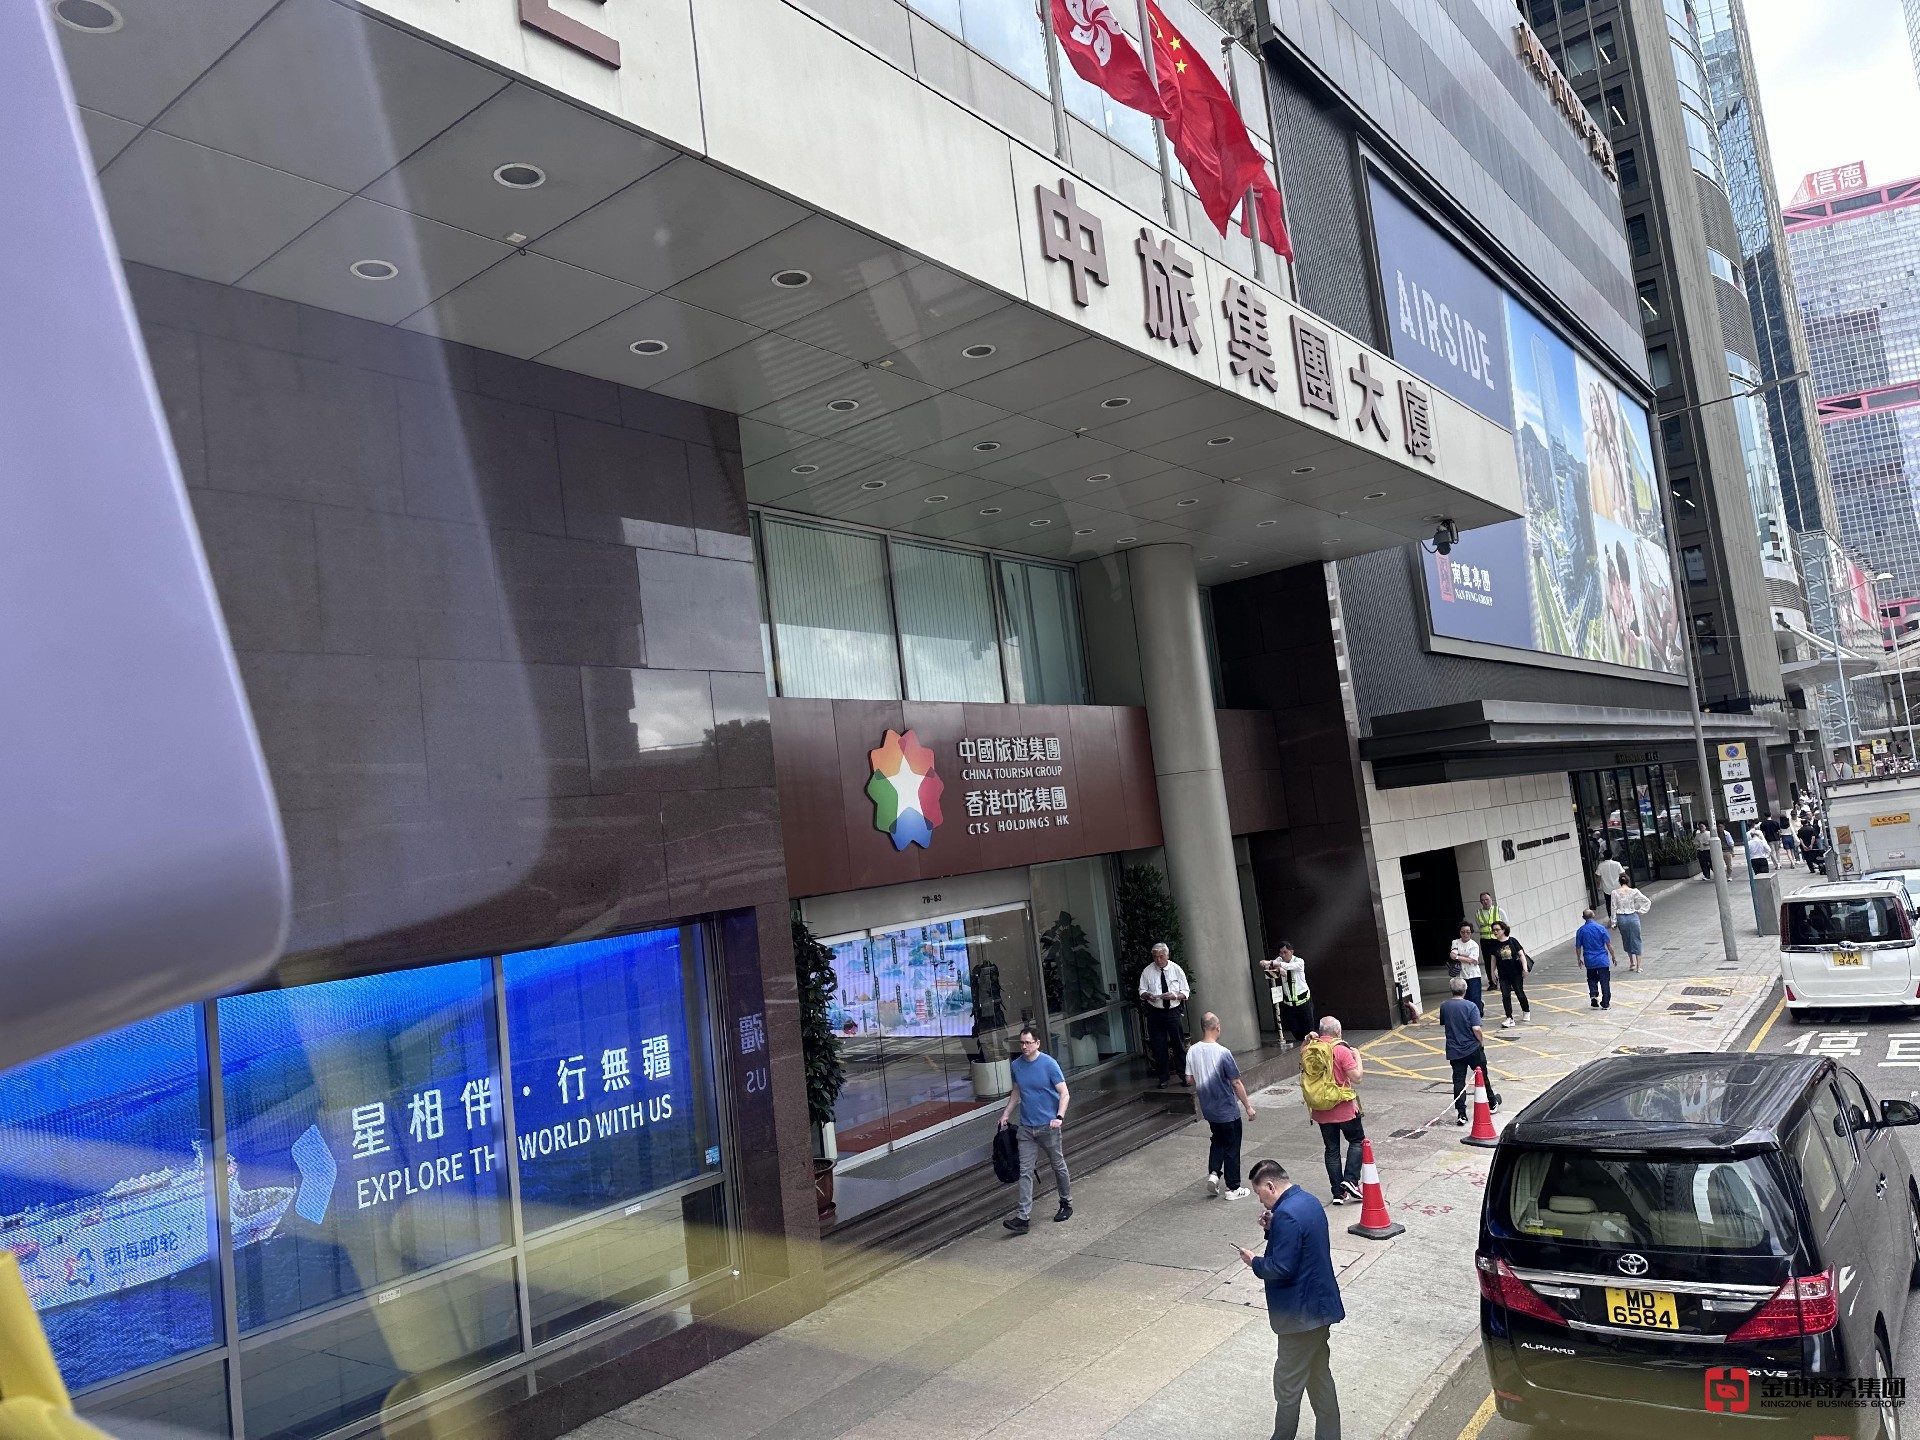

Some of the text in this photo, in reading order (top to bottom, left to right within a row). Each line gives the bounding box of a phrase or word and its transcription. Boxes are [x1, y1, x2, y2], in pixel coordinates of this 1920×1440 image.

[1811, 163, 1863, 194] 信德
[1035, 178, 1437, 463] 中旅集團大廈
[1396, 268, 1496, 391] AIRSIDE
[958, 737, 1061, 764] 中國旅遊集團
[962, 765, 1063, 781] CHINA TOURISM GROUP
[965, 786, 1068, 817] 香港中旅集團
[967, 814, 1070, 835] CTS HOLDINGS HK
[1838, 958, 1859, 966] 944
[357, 1093, 673, 1210] EXPLORE TH WORLD WITH US
[103, 1231, 178, 1265] 南海邮轮
[1626, 1290, 1655, 1308] MD
[1613, 1305, 1672, 1327] 6584
[1521, 1342, 1576, 1355] ALPHARD
